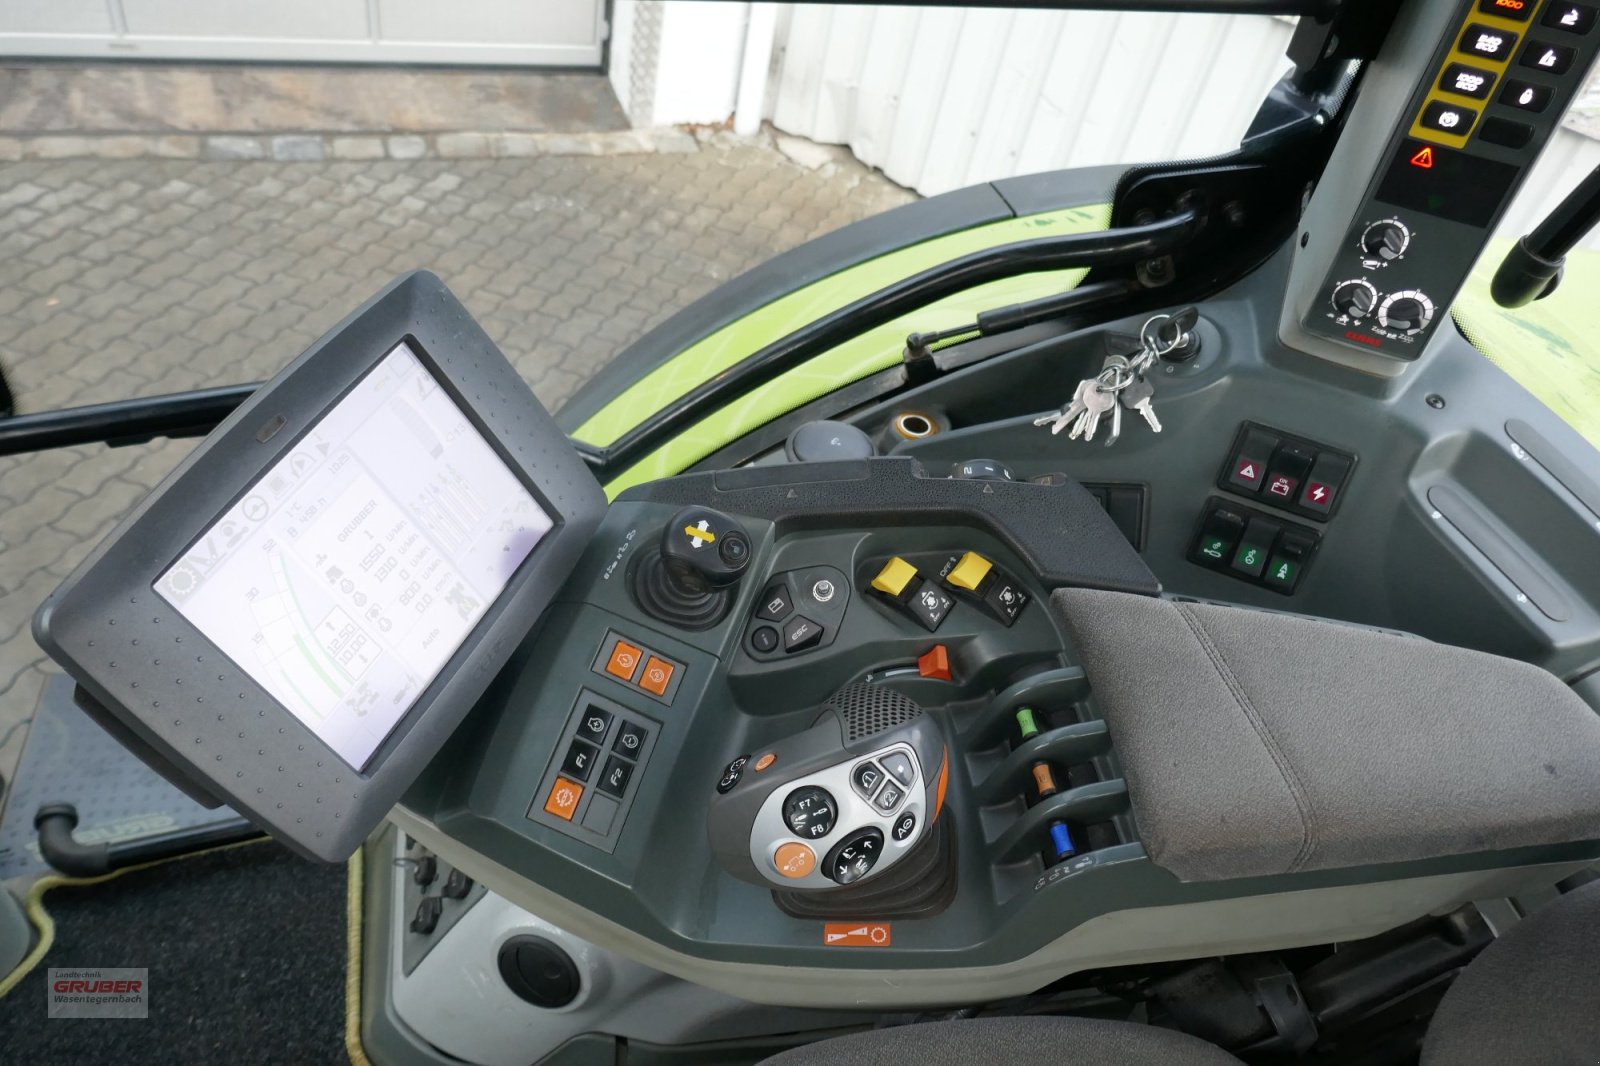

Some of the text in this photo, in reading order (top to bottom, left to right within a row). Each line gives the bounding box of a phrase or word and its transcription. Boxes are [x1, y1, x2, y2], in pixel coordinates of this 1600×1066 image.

[336, 498, 377, 542] GRUBBER
[359, 543, 385, 571] 1550
[373, 555, 398, 582] 1310
[398, 581, 421, 605] 800
[575, 753, 587, 769] F1
[610, 767, 623, 787] F2
[799, 798, 811, 810] F7
[810, 823, 824, 836] F8
